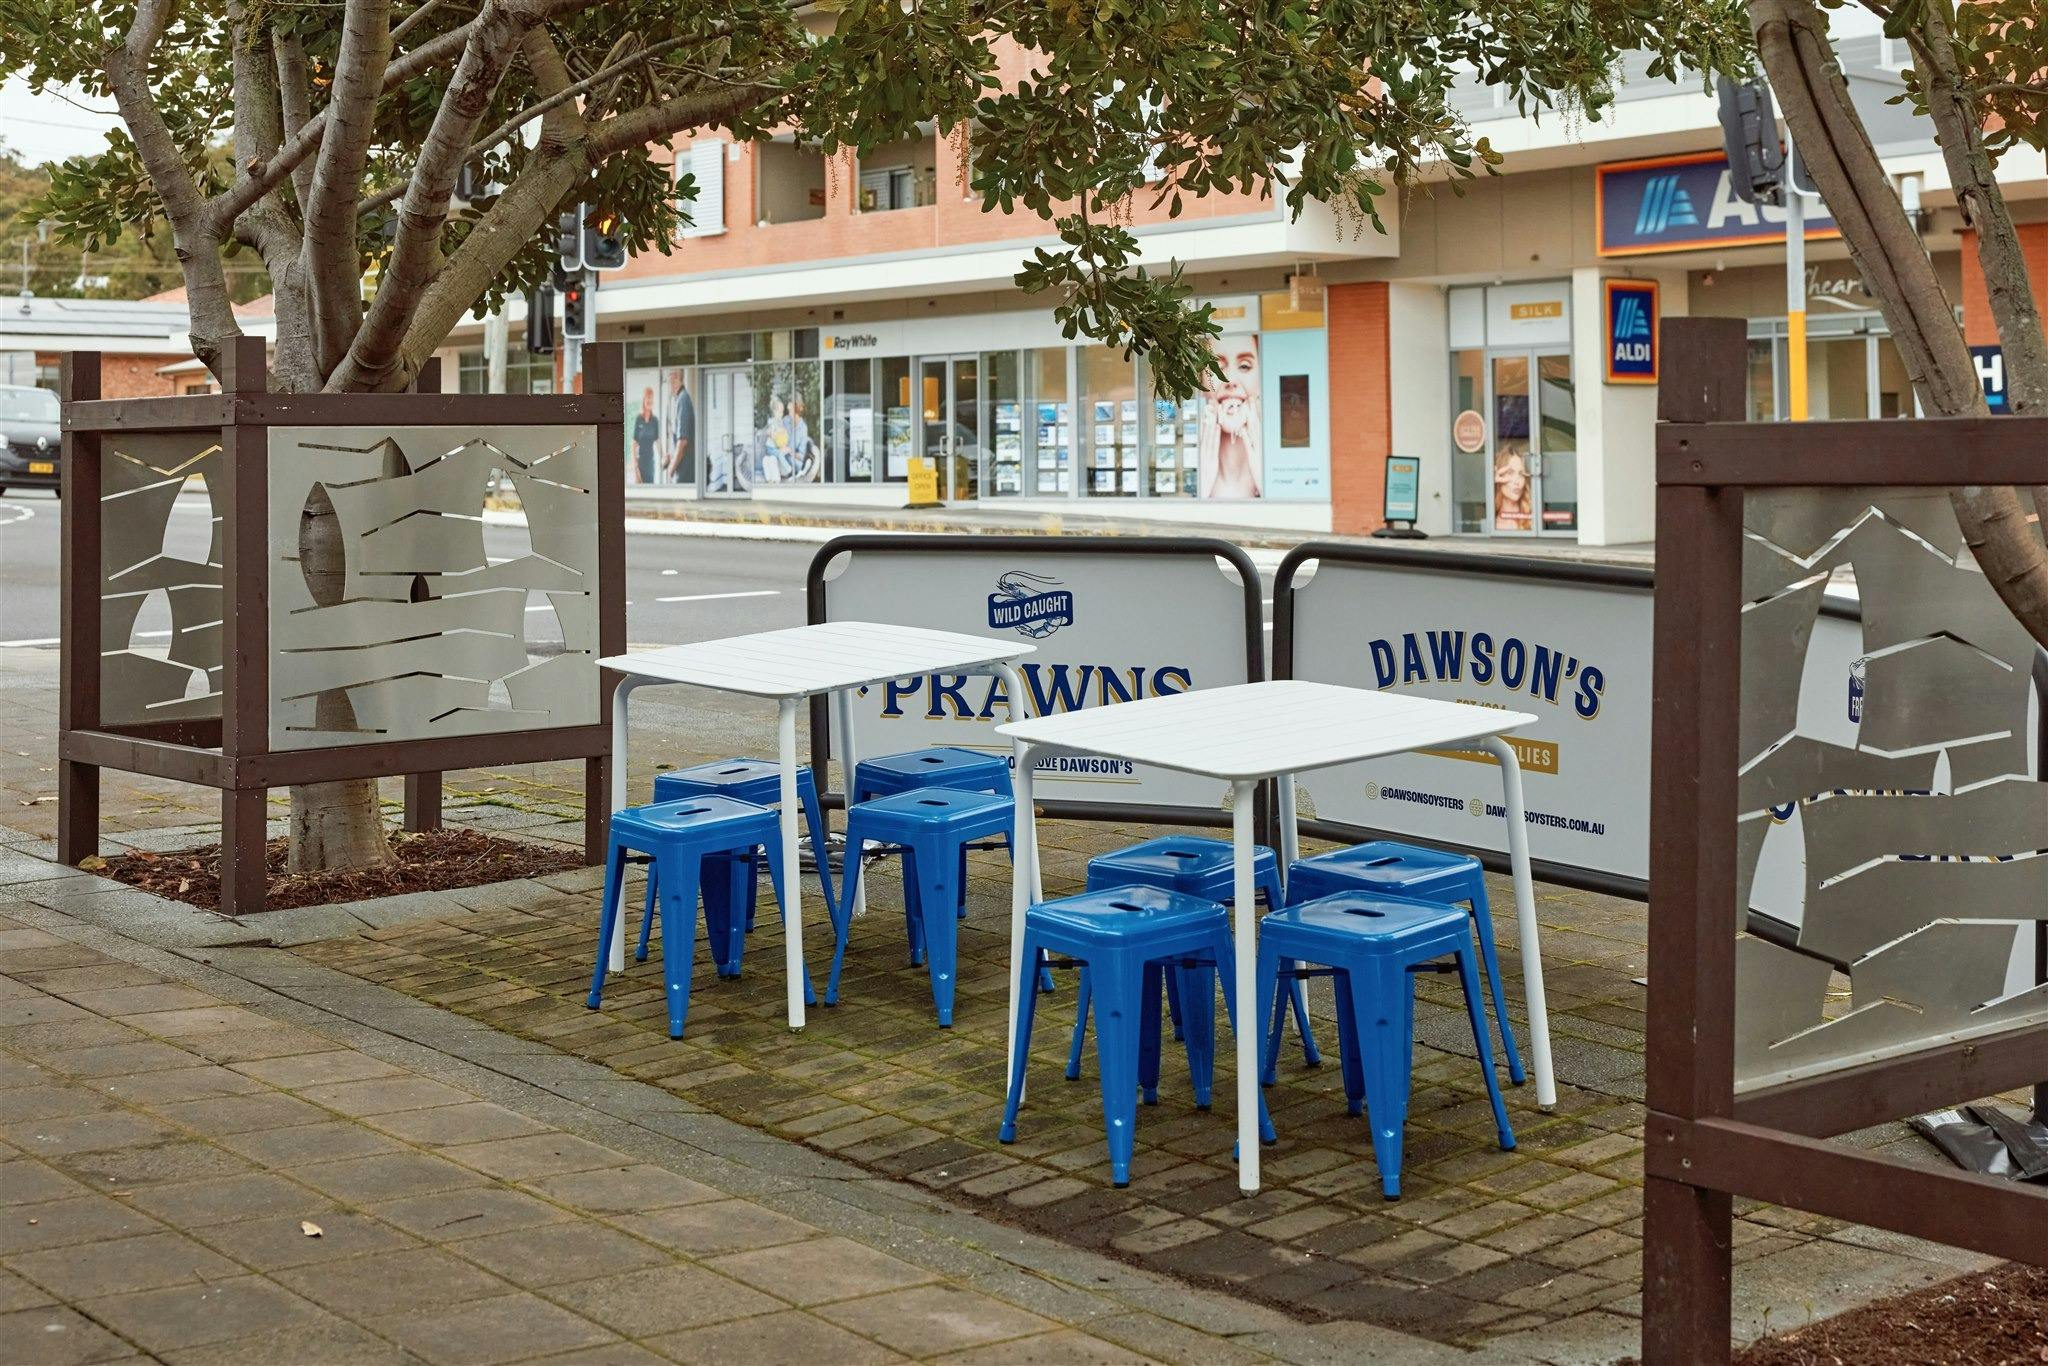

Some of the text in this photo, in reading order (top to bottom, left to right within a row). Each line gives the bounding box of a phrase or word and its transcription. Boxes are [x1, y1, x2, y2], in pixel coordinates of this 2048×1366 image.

[1519, 304, 1552, 317] SILK
[1614, 342, 1651, 362] ALDI
[994, 595, 1068, 624] WILD CAUGHT
[880, 663, 1192, 721] PRAWNS
[1060, 758, 1133, 775] DAWSON'S
[1381, 786, 1464, 811] @DAWSONSOYSTERS
